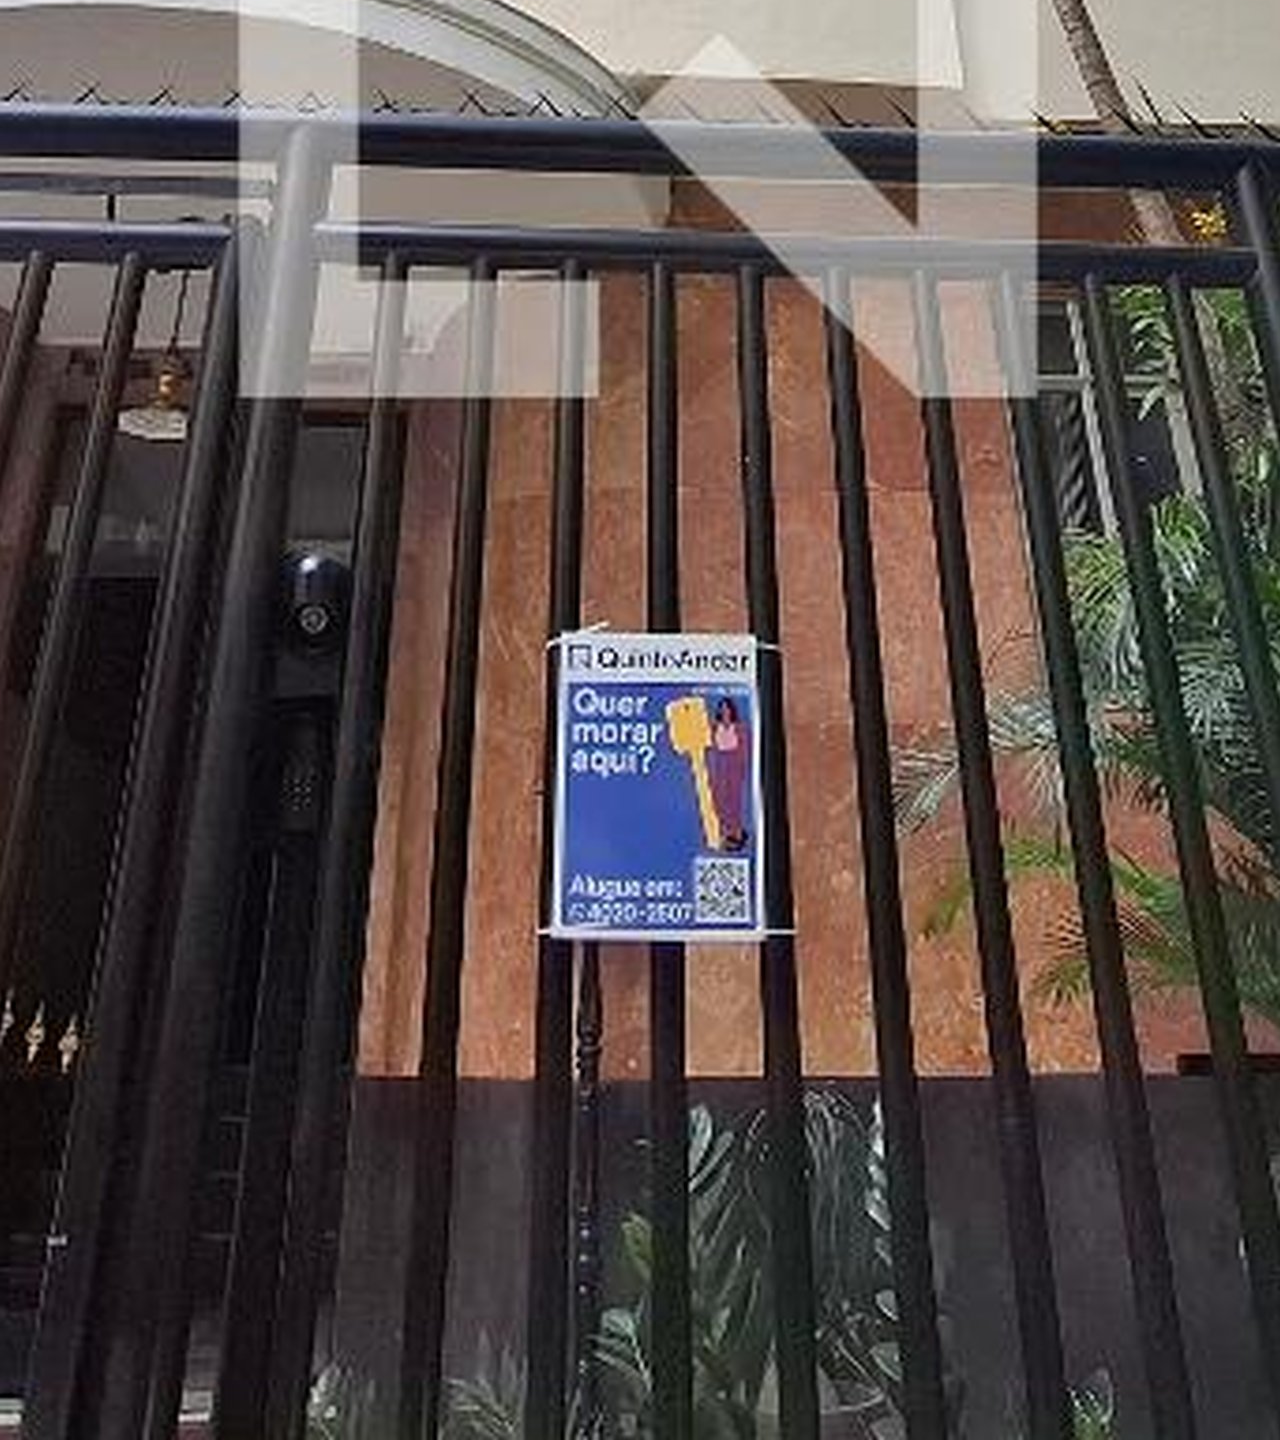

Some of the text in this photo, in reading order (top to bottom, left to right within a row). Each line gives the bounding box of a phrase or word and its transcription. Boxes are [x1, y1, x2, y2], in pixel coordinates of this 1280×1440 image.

[573, 687, 649, 716] Quer
[572, 722, 662, 743] morar
[571, 747, 656, 777] aqui?
[570, 874, 640, 901] Alugue
